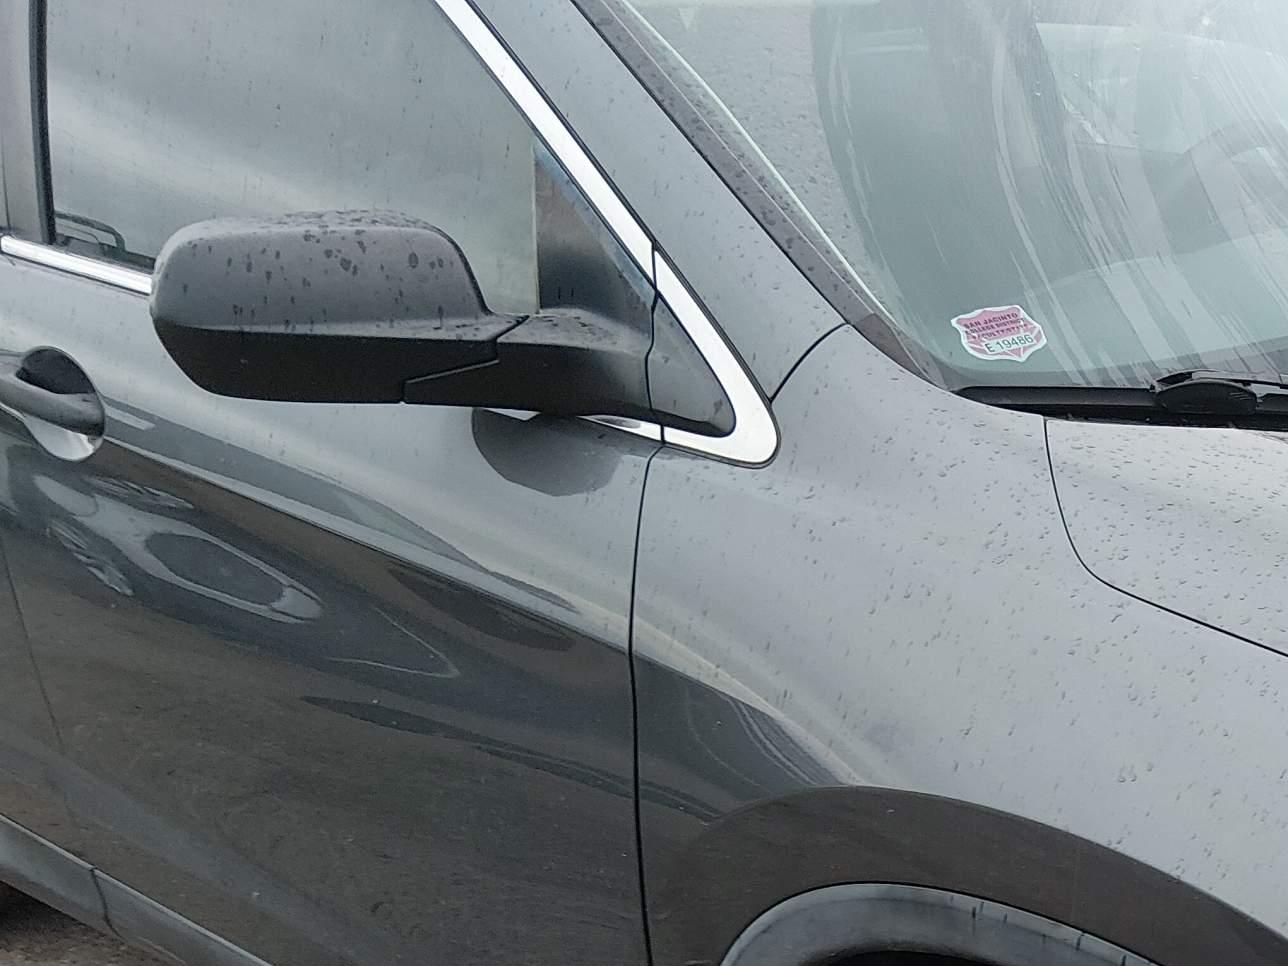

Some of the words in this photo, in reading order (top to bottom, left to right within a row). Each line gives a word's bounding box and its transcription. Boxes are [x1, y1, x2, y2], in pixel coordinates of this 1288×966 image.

[963, 320, 981, 329] SAN
[983, 312, 1018, 325] JACINTO
[985, 342, 995, 353] E
[996, 334, 1034, 350] 19486
